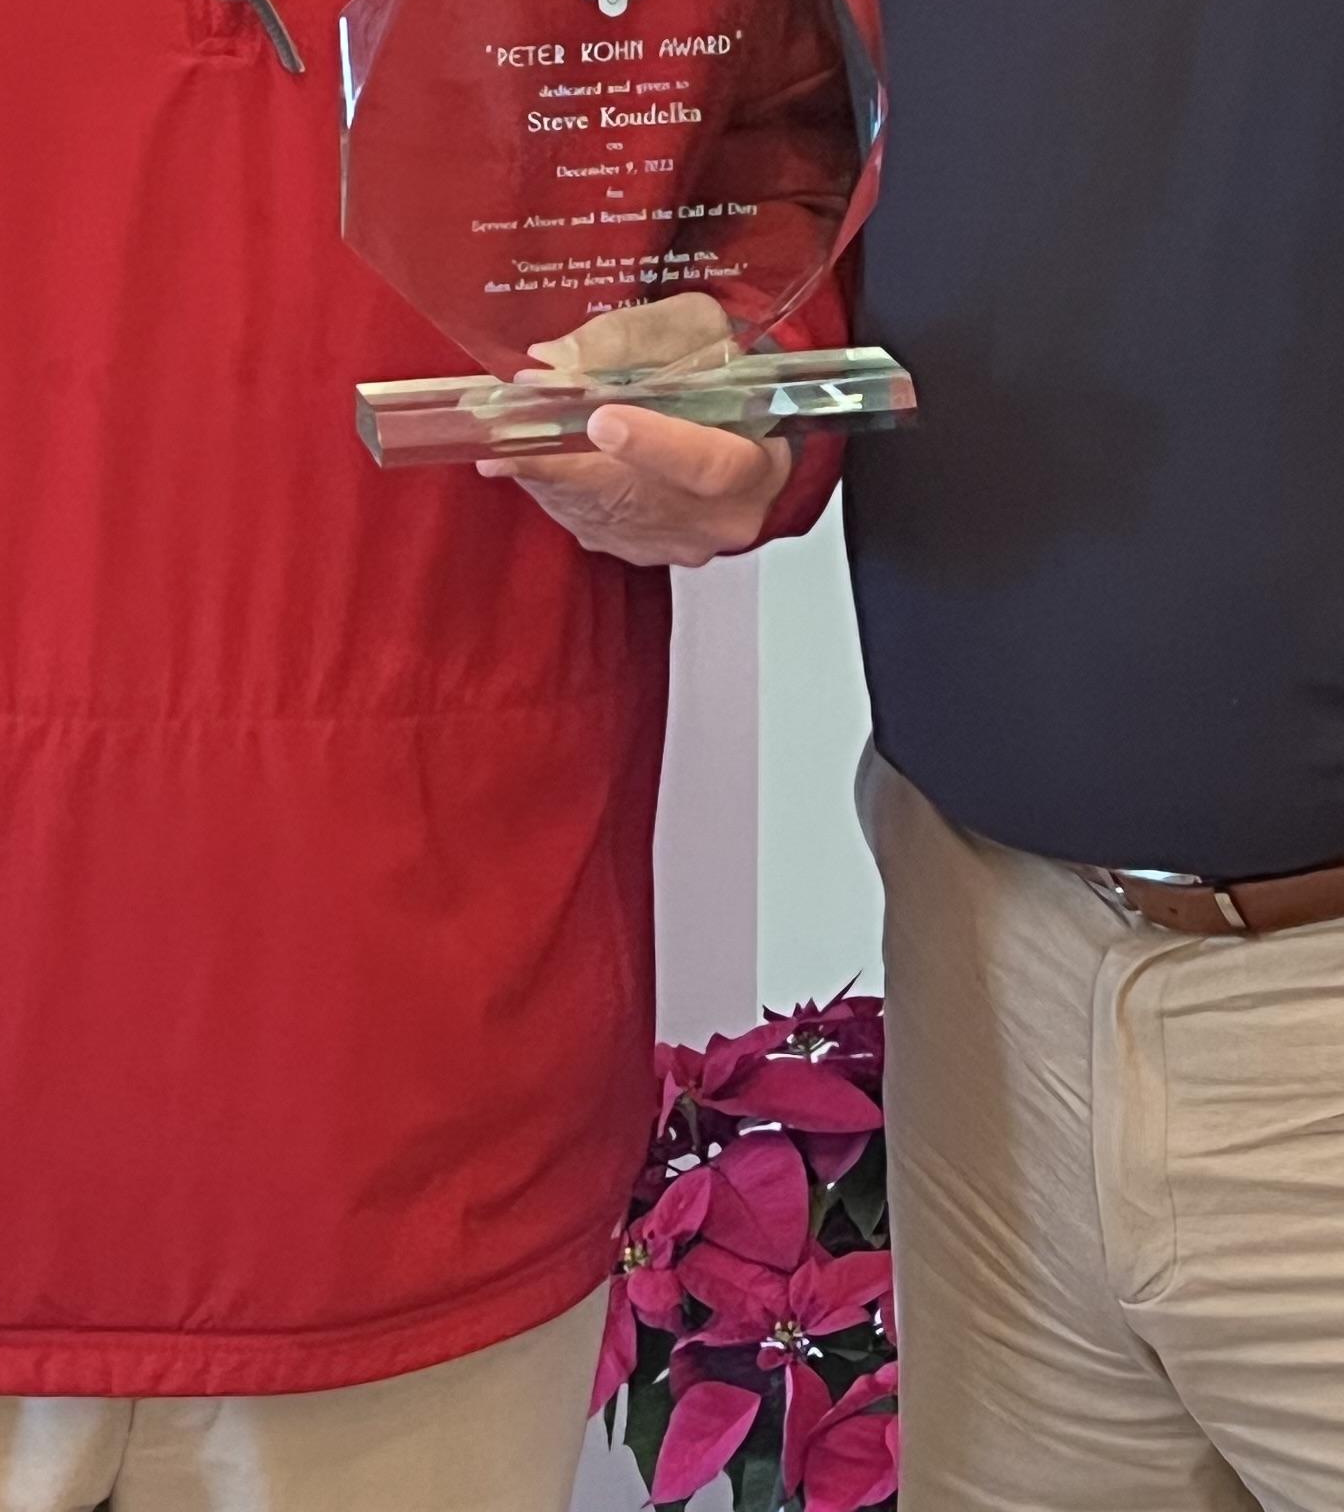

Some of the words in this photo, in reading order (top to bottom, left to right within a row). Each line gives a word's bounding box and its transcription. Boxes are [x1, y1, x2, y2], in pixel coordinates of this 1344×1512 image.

[580, 39, 644, 63] KOHN
[538, 81, 602, 98] dedicated
[607, 80, 631, 94] and
[636, 81, 671, 96] given
[675, 79, 690, 90] to
[527, 111, 589, 133] Steve
[600, 101, 703, 128] Koudelka
[556, 164, 621, 179] December
[523, 214, 566, 229] Above
[570, 211, 595, 226] and
[599, 208, 648, 224] Beyond
[651, 208, 674, 221] the
[678, 204, 705, 219] Call
[707, 203, 724, 217] of
[727, 202, 759, 216] Duty
